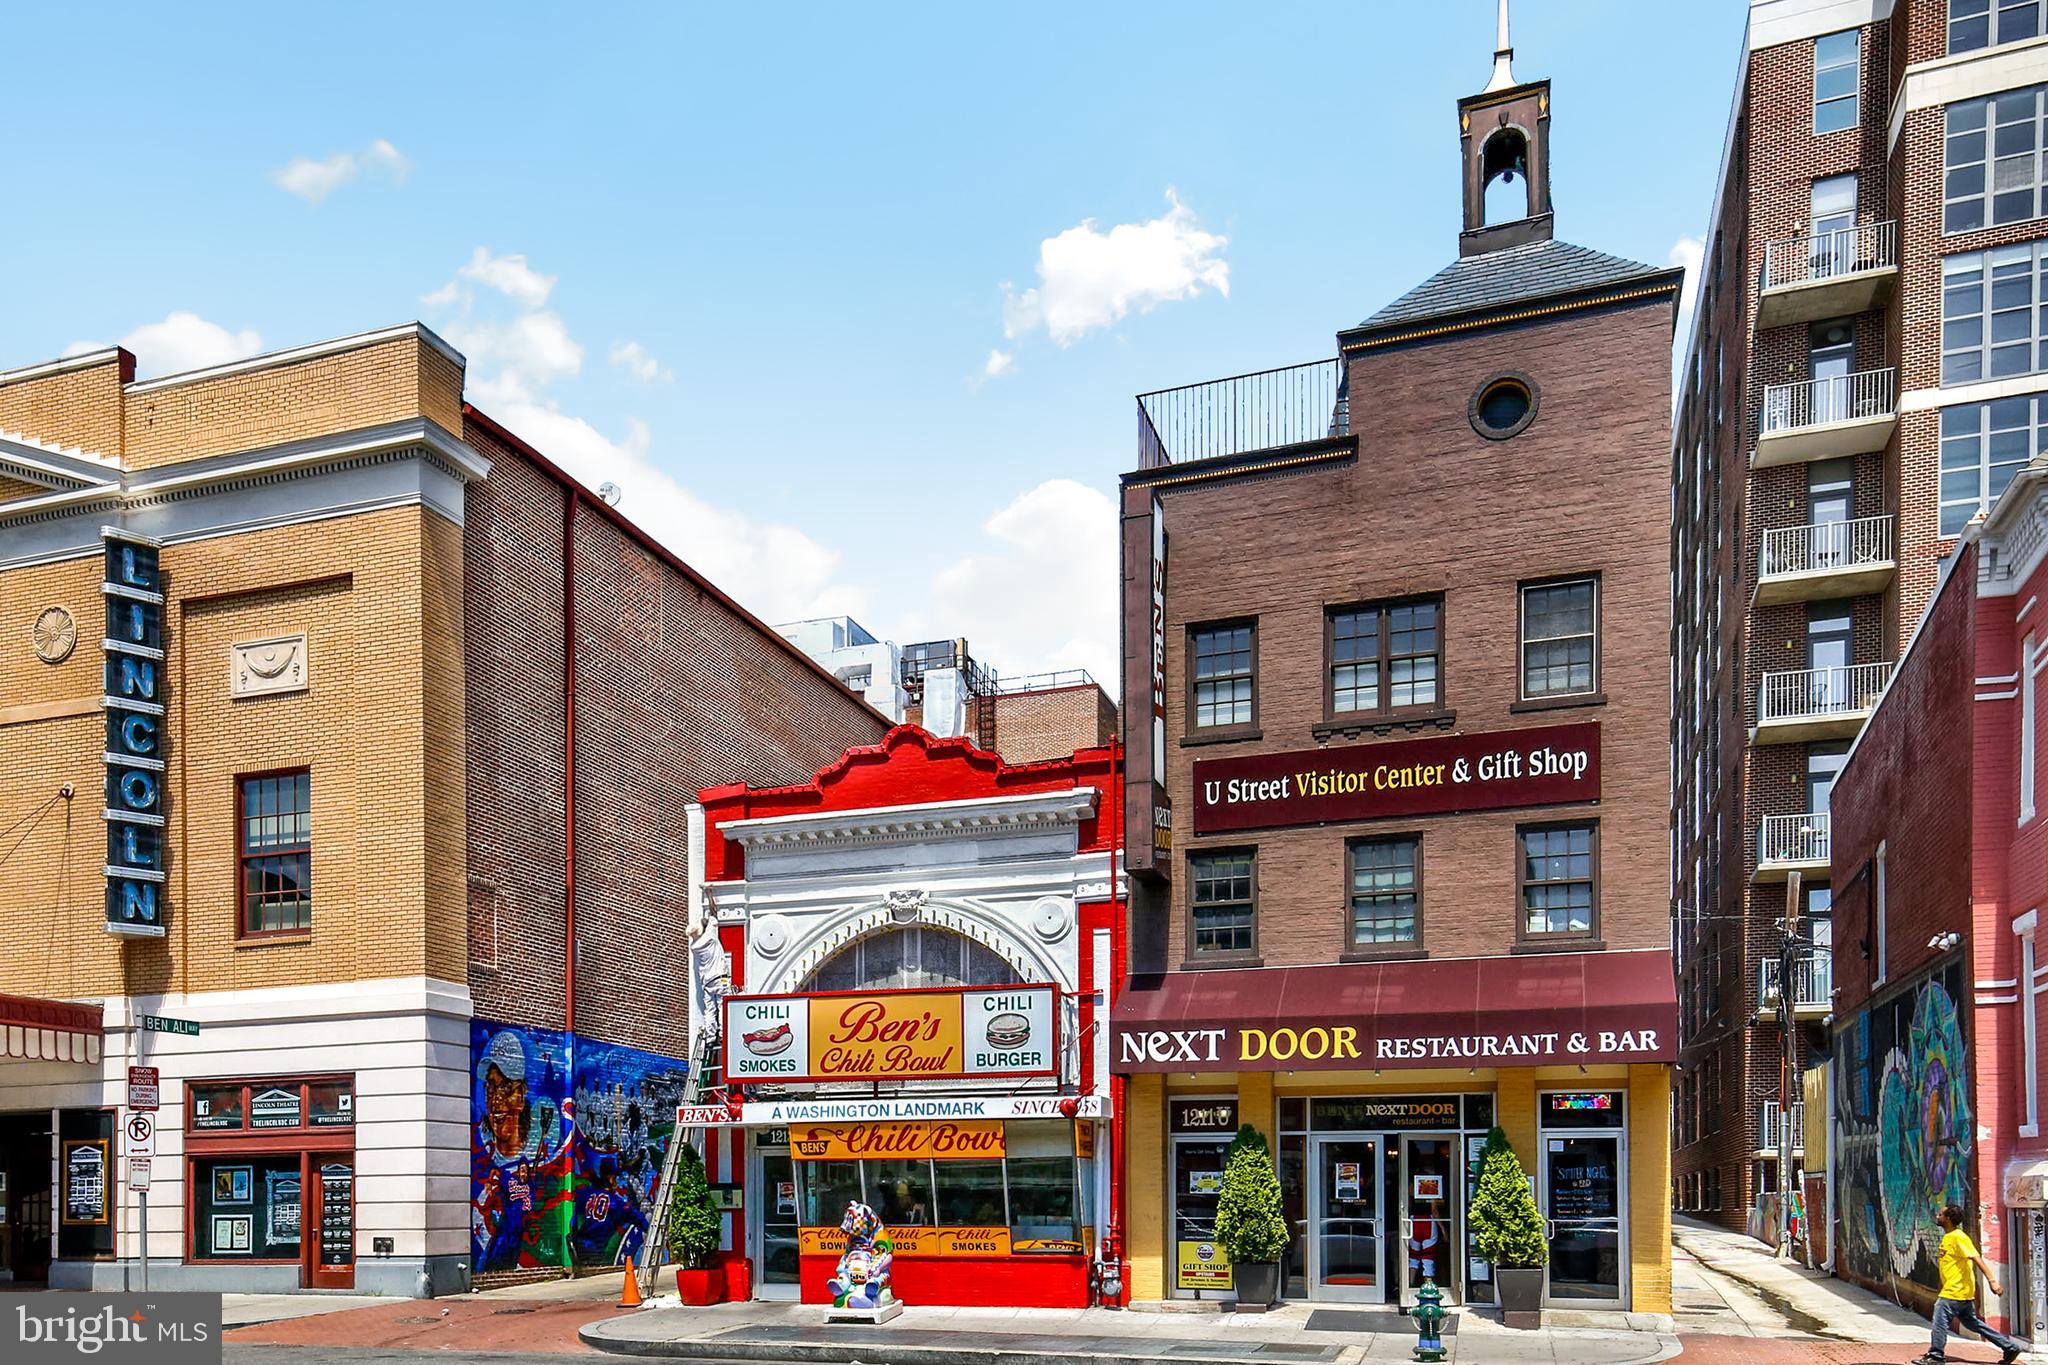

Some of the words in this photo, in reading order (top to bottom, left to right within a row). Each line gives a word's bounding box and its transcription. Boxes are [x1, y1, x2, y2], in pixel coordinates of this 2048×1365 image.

[121, 546, 156, 921] LINCOLN
[1204, 781, 1221, 805] U
[1227, 775, 1290, 804] Street
[1295, 770, 1368, 798] Visitor
[1374, 763, 1446, 791] Center
[1451, 756, 1472, 784] &
[1478, 749, 1523, 781] Gift
[1528, 746, 1589, 781] Shop
[983, 994, 1032, 1012] CHILI
[745, 1005, 790, 1020] CHILI
[146, 1017, 168, 1031] BEN
[172, 1020, 188, 1034] ALI
[188, 1024, 198, 1033] WAY
[829, 1000, 942, 1044] Ben's
[1238, 1026, 1362, 1062] DOOR
[1376, 1032, 1559, 1060] RESTAURANT
[1566, 1032, 1591, 1054] &
[1598, 1030, 1660, 1052] BAR
[739, 1059, 796, 1073] SMOKES
[819, 1047, 875, 1074] Chili
[879, 1044, 954, 1073] Bowl
[976, 1051, 1042, 1068] BURGER
[772, 1107, 783, 1120] A
[786, 1104, 890, 1119] WASHINGTON
[894, 1102, 986, 1117] LANDMARK
[1011, 1100, 1061, 1115] SINCE
[1182, 1108, 1214, 1127] 1211
[1408, 1103, 1456, 1116] DOOR
[1392, 1118, 1435, 1126] restaurant
[1442, 1117, 1456, 1125] bar
[770, 1129, 790, 1144] 121
[800, 1141, 826, 1154] BEN'S
[846, 1123, 922, 1153] Chili
[956, 1228, 992, 1240] Chili
[952, 1242, 997, 1251] SMOKES
